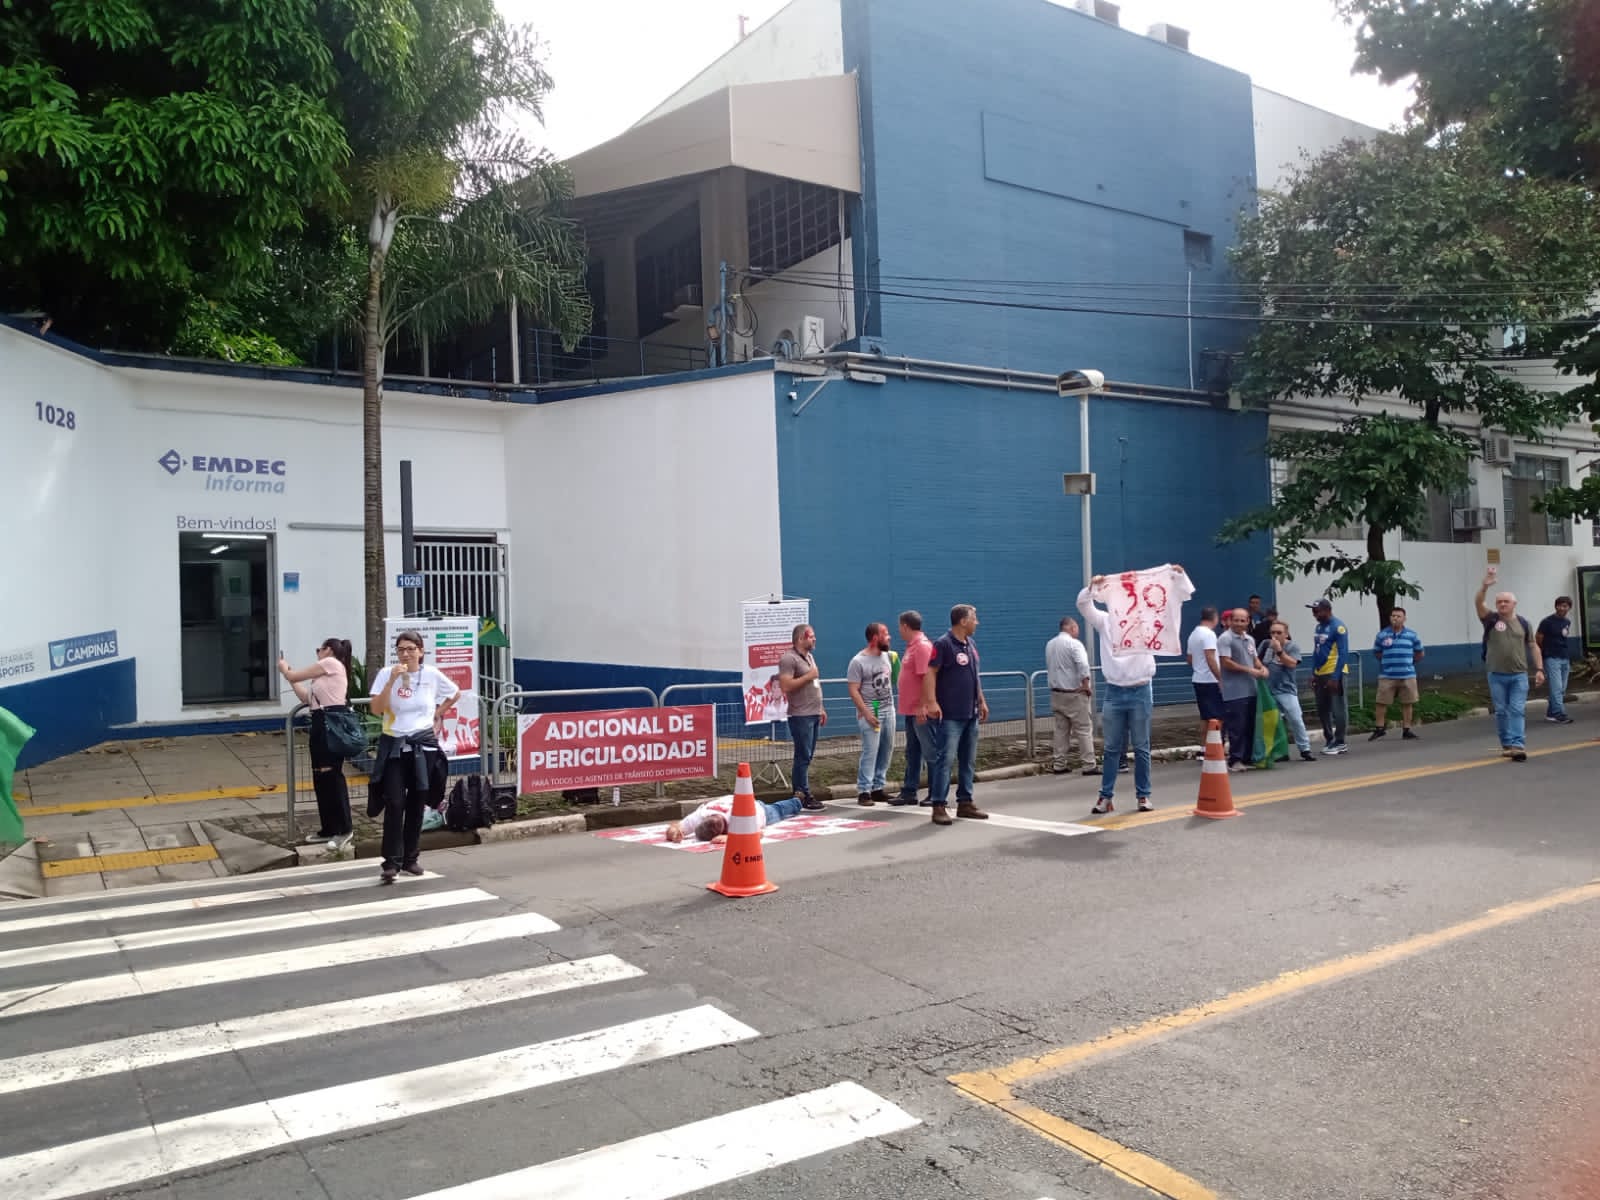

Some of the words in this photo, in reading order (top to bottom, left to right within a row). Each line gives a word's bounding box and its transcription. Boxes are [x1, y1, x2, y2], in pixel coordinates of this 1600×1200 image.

[35, 402, 76, 430] 1028
[192, 455, 286, 476] EMDEC
[205, 475, 286, 494] Informa
[176, 515, 277, 531] Bem-vindos!
[399, 575, 422, 586] 1028
[66, 641, 116, 662] CAMPINAS
[544, 716, 664, 741] ADICIONAL
[668, 714, 695, 733] DE
[529, 739, 707, 771] PERICULOSIDADE
[531, 778, 550, 788] PARA
[551, 777, 573, 786] TODOS
[575, 776, 584, 785] OS
[585, 773, 614, 783] AGENTES
[615, 772, 624, 780] DE
[655, 769, 665, 777] DO
